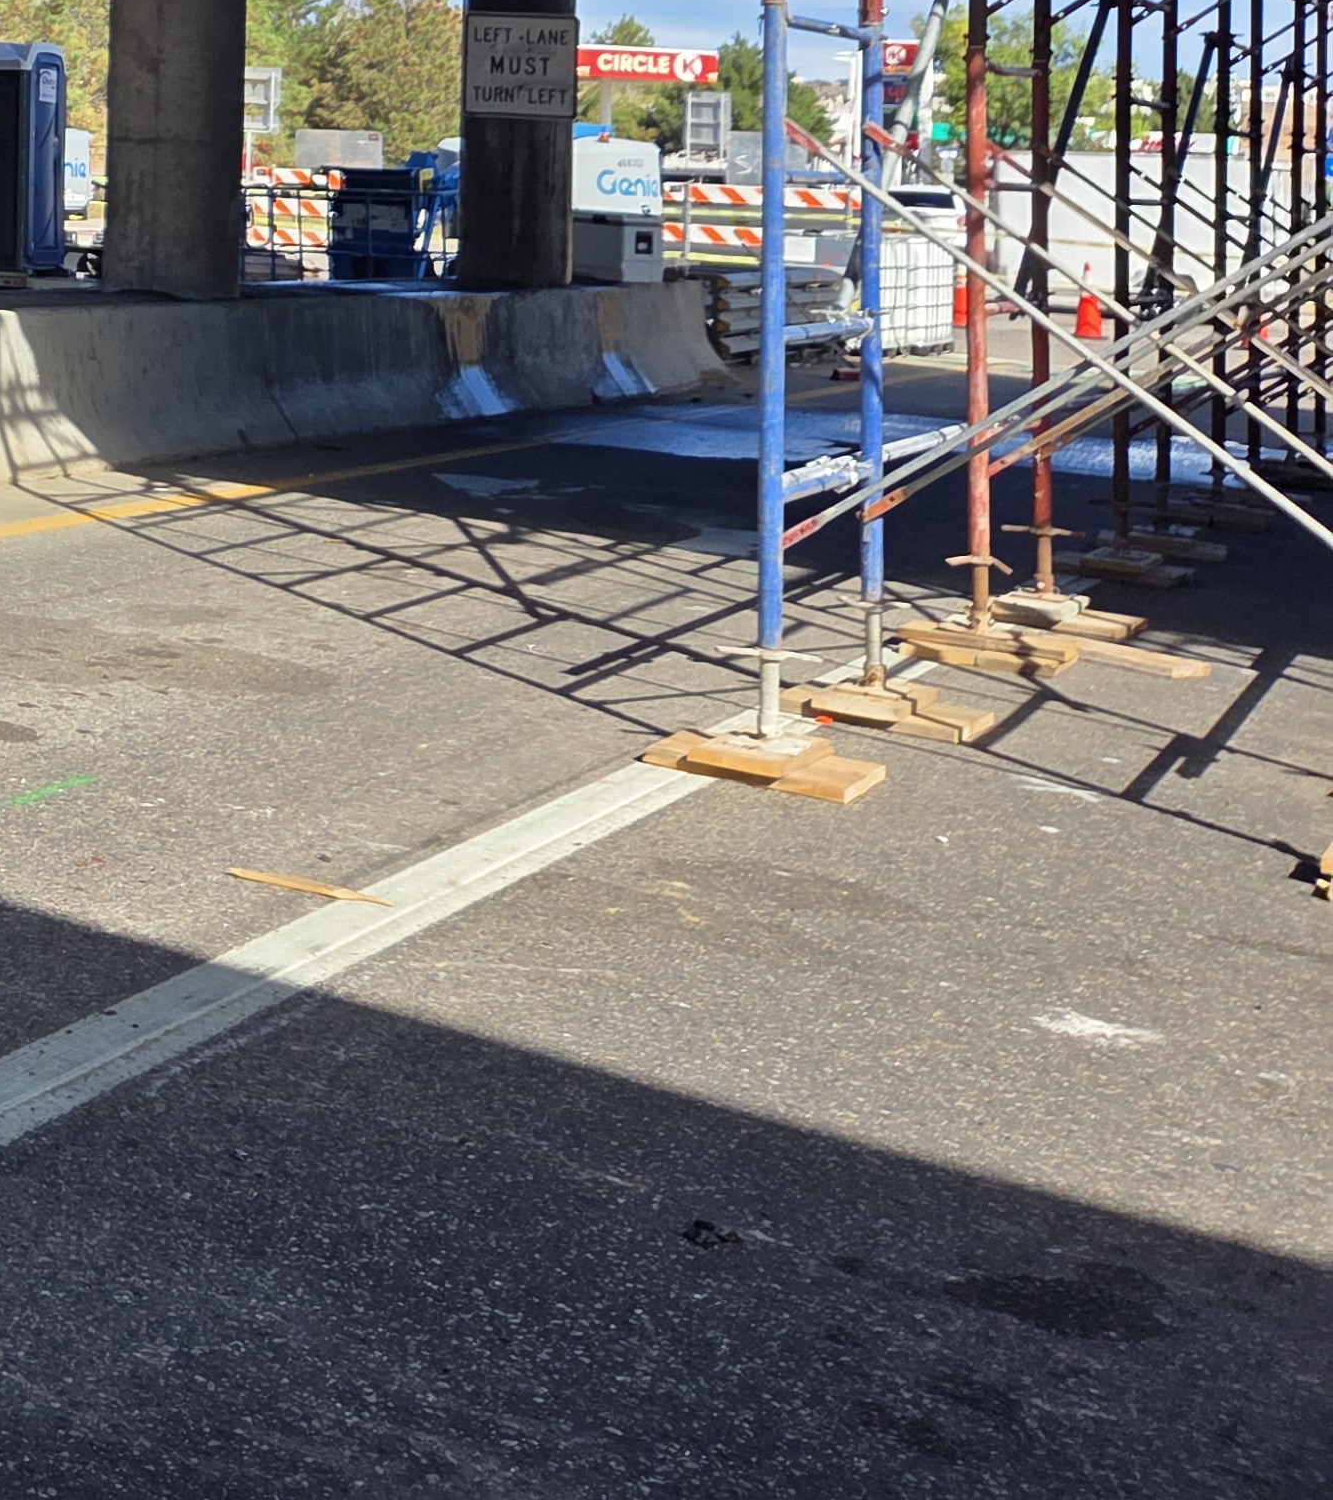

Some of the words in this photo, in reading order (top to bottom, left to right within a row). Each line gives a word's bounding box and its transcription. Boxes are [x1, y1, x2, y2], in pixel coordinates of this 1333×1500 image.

[474, 26, 512, 43] LEFT
[526, 28, 570, 46] LANE
[489, 55, 551, 77] MUST
[597, 53, 671, 75] CIRCLE
[473, 85, 515, 104] TURN
[527, 87, 569, 106] LEFT
[63, 157, 87, 178] nie
[596, 169, 659, 198] Genie
